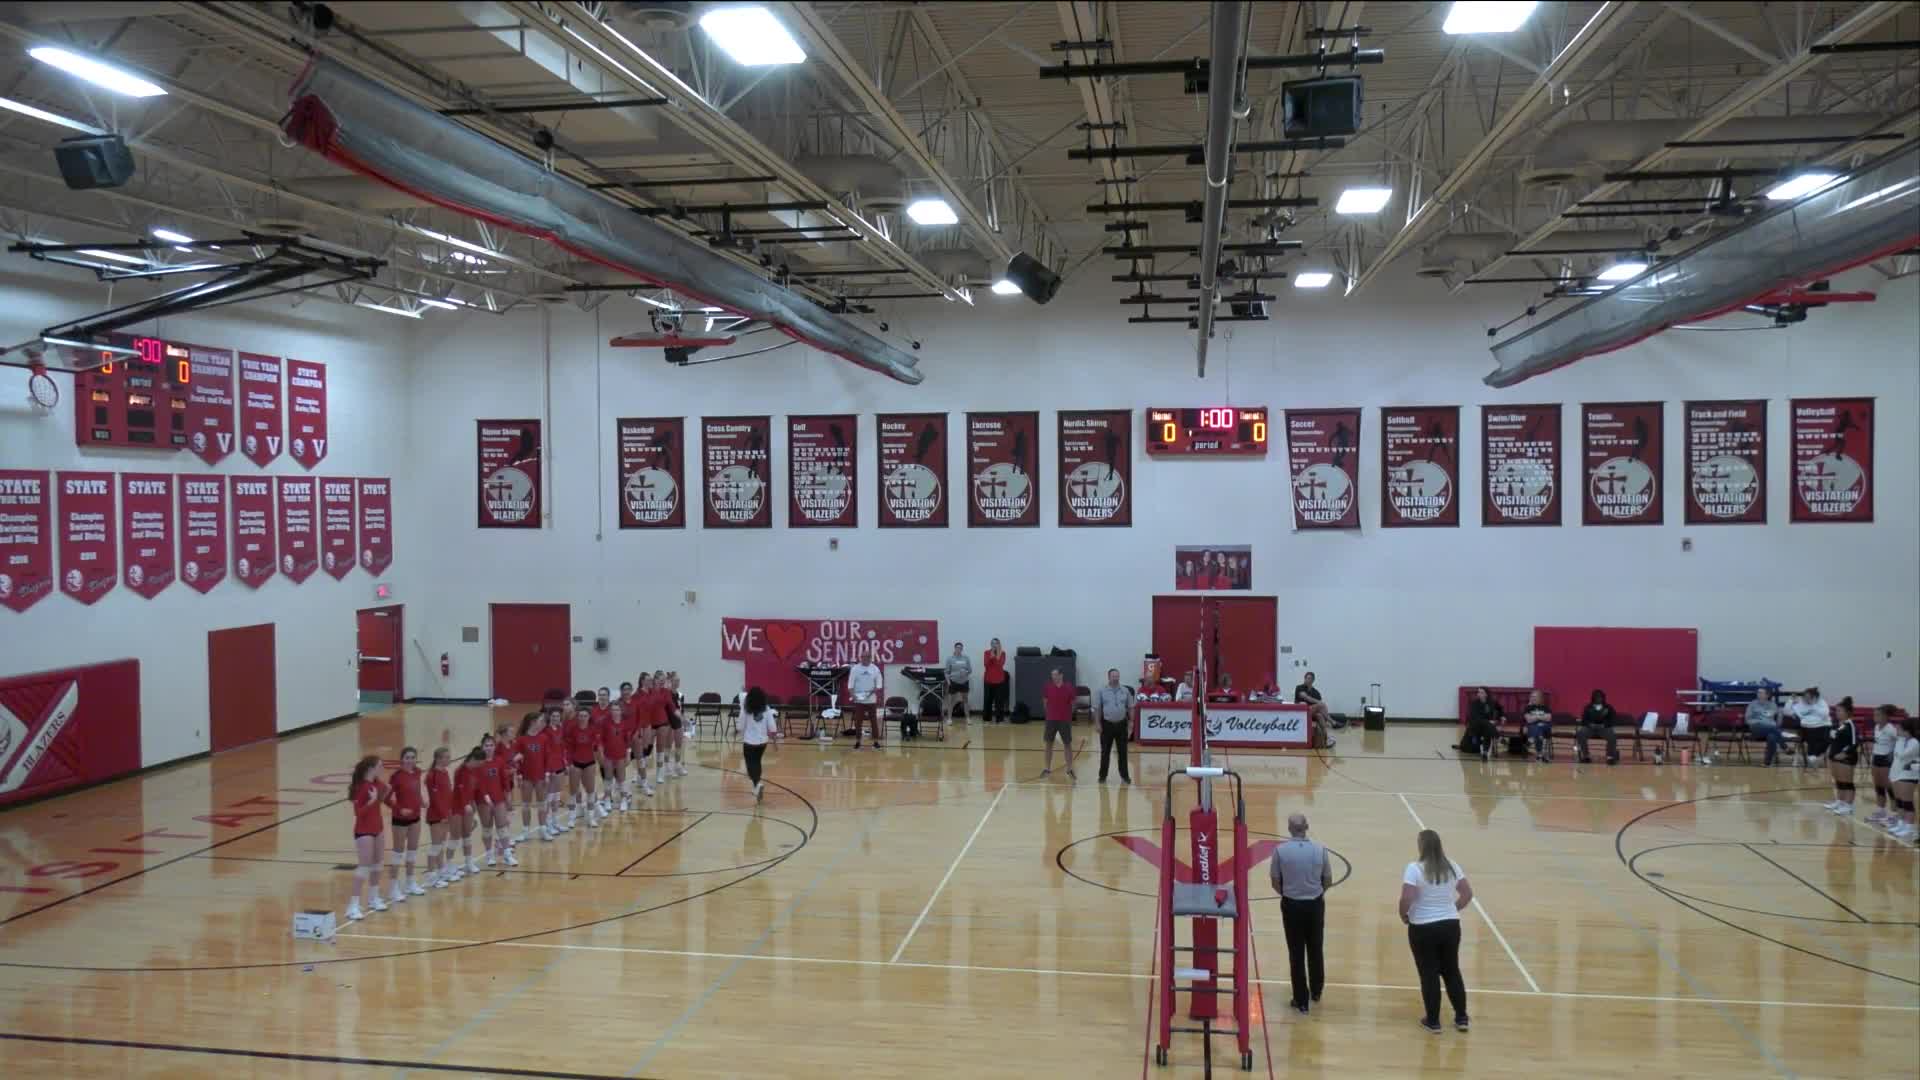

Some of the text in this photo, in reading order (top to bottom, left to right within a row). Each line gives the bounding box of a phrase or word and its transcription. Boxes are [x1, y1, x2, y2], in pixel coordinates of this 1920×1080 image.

[179, 360, 189, 383] 0
[1201, 409, 1233, 428] 1:00
[882, 422, 906, 430] Hockey
[972, 420, 1002, 429] Lacrosse
[1164, 423, 1176, 442] 0
[1253, 422, 1265, 442] 0
[216, 432, 232, 453] V
[266, 436, 280, 456] V
[312, 439, 325, 458] V
[66, 480, 107, 494] STATE
[129, 481, 166, 494] STATE
[185, 482, 219, 495] STATE
[236, 483, 267, 495] STATE
[283, 483, 311, 495] STATE
[325, 484, 350, 495] STATE
[363, 484, 386, 495] STATE
[1395, 496, 1445, 506] VISITATION
[1496, 495, 1548, 505] VISITATION
[1597, 494, 1649, 504] VISITATION
[1699, 493, 1752, 503] VISITATION
[1805, 491, 1859, 501] VISITATION
[488, 500, 530, 509] VISITATION
[630, 500, 673, 510] VISITATION
[715, 500, 759, 509] VISITATION
[801, 499, 845, 508] VISITATION
[890, 499, 935, 508] VISITATION
[980, 498, 1026, 508] VISITATION
[1071, 497, 1118, 507] VISITATION
[1299, 499, 1348, 509] VISITATION
[1811, 502, 1853, 512] BLAZERS
[985, 508, 1022, 518] BLAZERS
[1076, 508, 1113, 518] BLAZERS
[1400, 507, 1440, 517] BLAZERS
[1502, 506, 1542, 517] BLAZERS
[1602, 505, 1643, 516] BLAZERS
[1705, 504, 1746, 514] BLAZERS
[493, 510, 526, 520] BLAZERS
[635, 511, 669, 520] BLAZERS
[720, 511, 753, 520] BLAZERS
[806, 510, 840, 519] BLAZERS
[895, 510, 931, 519] BLAZERS
[1304, 510, 1343, 520] BLAZERS
[820, 621, 862, 640] OUR
[722, 624, 764, 652] WE
[807, 638, 895, 662] SENIORS
[1226, 716, 1300, 734] Volleyball
[22, 710, 65, 770] BLAZERS
